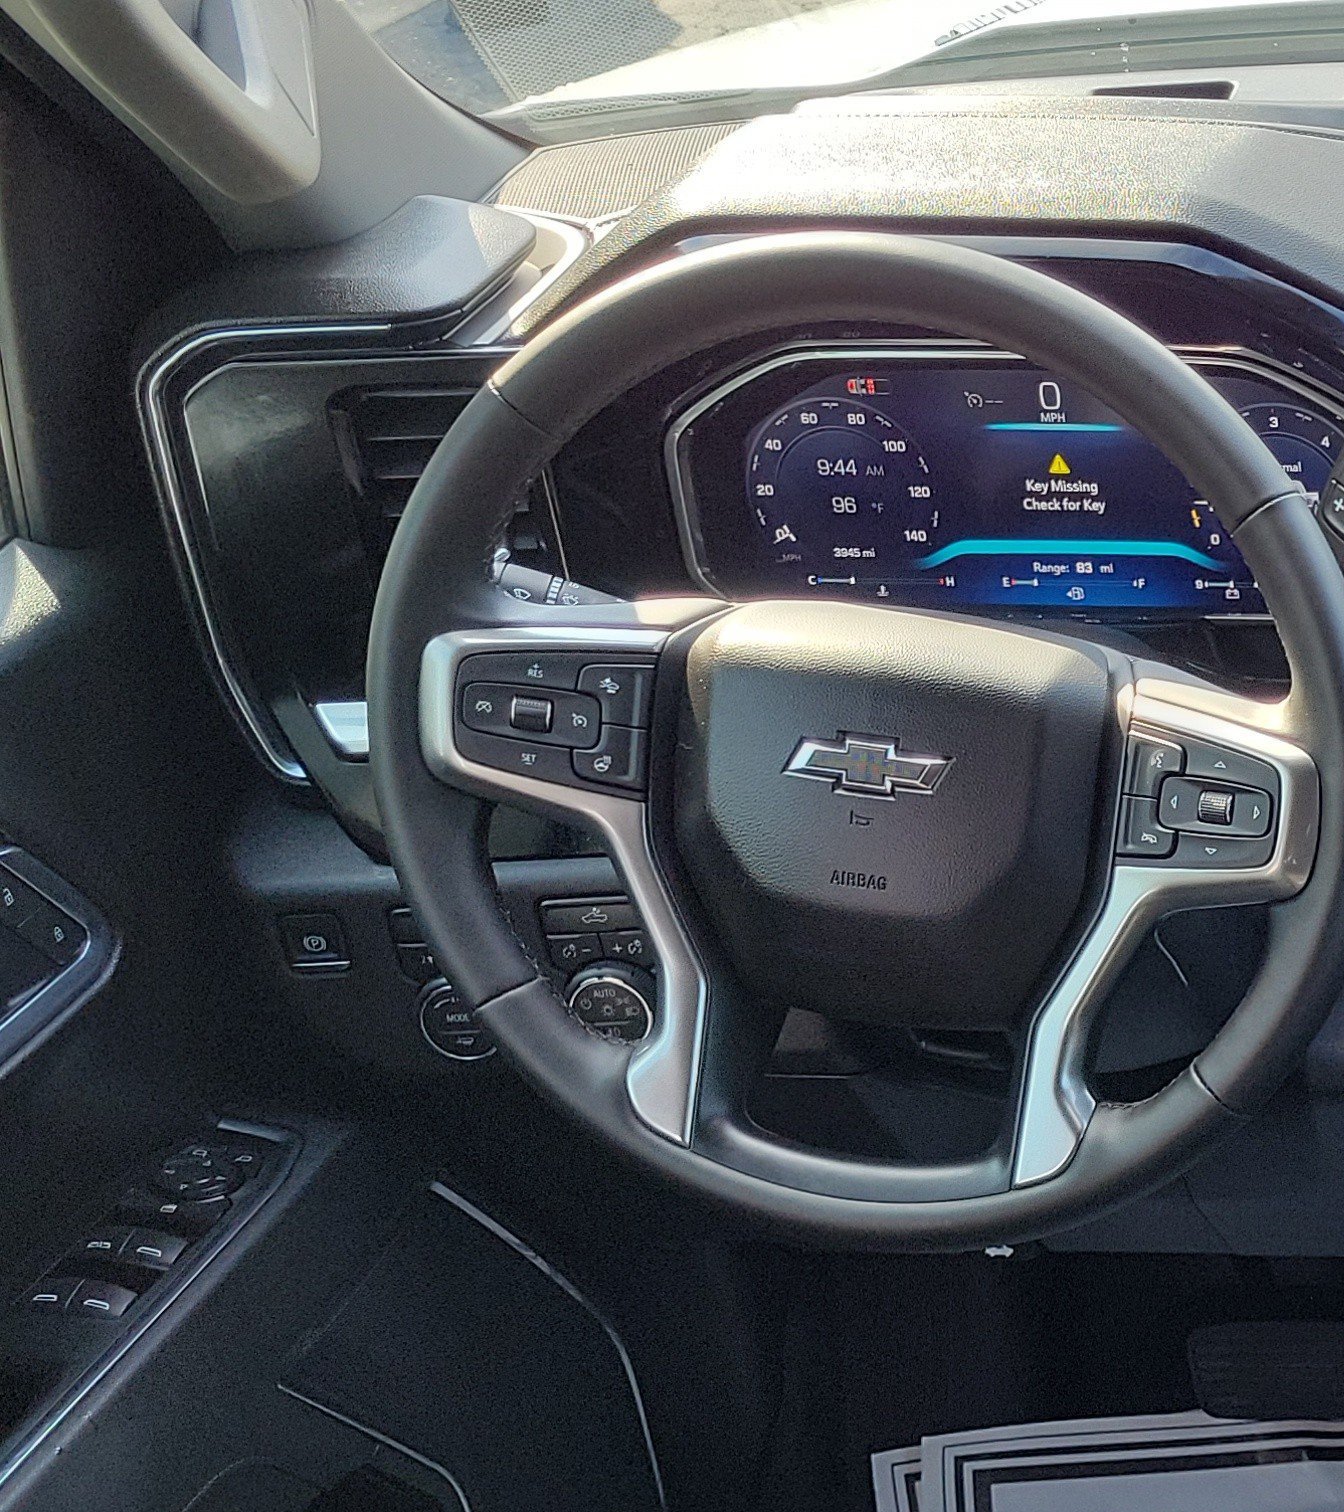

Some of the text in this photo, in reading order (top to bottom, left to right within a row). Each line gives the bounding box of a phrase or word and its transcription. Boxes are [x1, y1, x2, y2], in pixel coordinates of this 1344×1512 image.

[1038, 381, 1061, 410] 0
[800, 413, 818, 425] 60
[847, 413, 866, 425] 80
[1040, 412, 1066, 423] MPH
[1269, 416, 1279, 428] 3
[764, 439, 782, 451] 40
[882, 440, 906, 452] 100
[1321, 436, 1331, 448] 4
[817, 459, 885, 476] 9:44 AM
[756, 484, 774, 496] 20
[908, 486, 931, 498] 120
[1025, 479, 1099, 496] Key Missing
[832, 496, 857, 513] 96
[1023, 498, 1106, 514] Check for Key
[904, 530, 927, 542] 140
[1210, 534, 1220, 545] 0
[833, 547, 875, 558] 3945 mi
[1033, 562, 1070, 575] Range:
[1076, 562, 1093, 573] 83
[808, 575, 817, 585] C
[945, 577, 955, 587] H
[1002, 577, 1011, 588] E
[1138, 578, 1146, 589] F
[521, 753, 537, 763] SET
[830, 869, 887, 890] AIRBAG
[593, 988, 616, 998] AUTO
[446, 1013, 470, 1023] MODE
